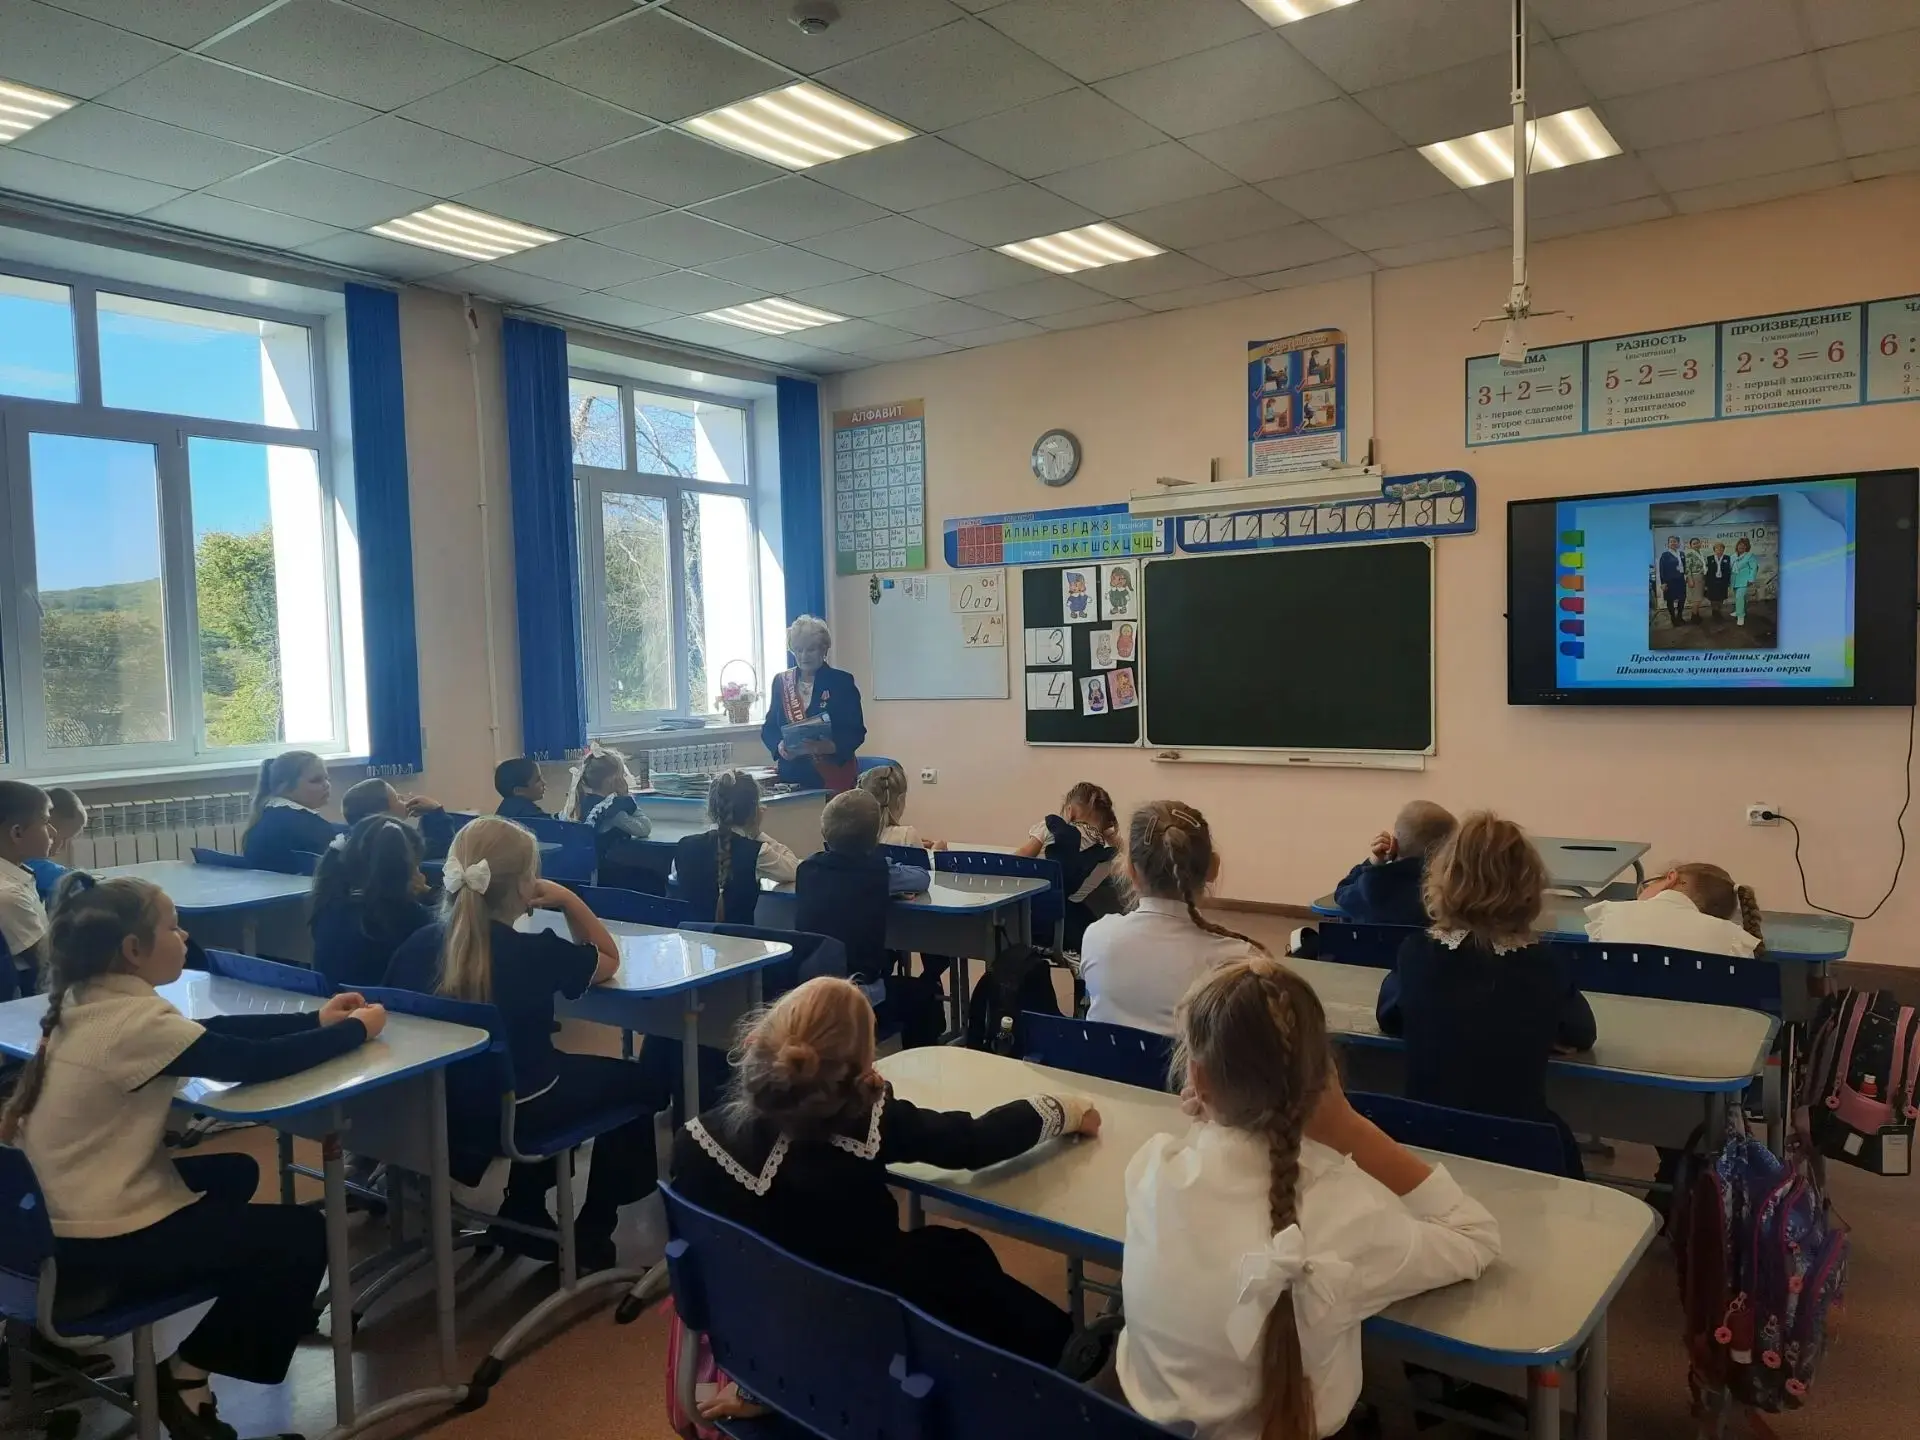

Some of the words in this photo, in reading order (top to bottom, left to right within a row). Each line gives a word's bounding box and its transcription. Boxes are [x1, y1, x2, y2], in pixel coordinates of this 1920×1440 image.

[1731, 311, 1852, 336] ПРОИЗВЕДЕНИЕ
[1616, 334, 1687, 351] РАЗНОСТЬ
[1880, 333, 1898, 356] 6
[1736, 352, 1752, 373] 2
[1772, 347, 1789, 369] 3
[1827, 340, 1845, 362] 6
[1605, 369, 1619, 390] 5
[1638, 364, 1653, 386] 2
[1682, 359, 1698, 380] 3
[1744, 377, 1786, 390] первый
[1790, 371, 1856, 384] множитель
[1478, 386, 1491, 406] 3
[1517, 380, 1531, 401] 2
[1558, 374, 1572, 396] 5
[1624, 389, 1695, 404] уменьшаемое
[1744, 389, 1782, 401] второй
[1786, 382, 1852, 395] множитель
[1491, 409, 1522, 419] первое
[1525, 403, 1574, 414] слагаемое
[1624, 401, 1687, 414] вычитаемое
[1744, 398, 1822, 412] произведение
[851, 405, 905, 423] АЛФАВИТ
[1491, 420, 1522, 430] второе
[1524, 414, 1573, 425] слагаемое
[1624, 414, 1670, 426] разность
[1491, 430, 1520, 440] сумма
[1192, 520, 1208, 545] 0
[1219, 518, 1233, 543] 1
[1245, 514, 1260, 540] 2
[1272, 512, 1288, 537] 3
[1300, 508, 1314, 535] 4
[1327, 507, 1343, 533] 5
[1356, 504, 1374, 530] 6
[1387, 501, 1403, 528] 7
[1415, 499, 1433, 527] 8
[1448, 496, 1465, 523] 9
[1750, 527, 1765, 539] 10
[1047, 628, 1064, 663] 3
[1630, 653, 1700, 664] Председатель
[1703, 652, 1761, 661] Почётных
[1763, 652, 1811, 662] граждан
[1616, 666, 1684, 675] Шкотовского
[1686, 665, 1774, 676] муниципального
[1775, 665, 1812, 675] округа
[1047, 673, 1066, 708] 4
